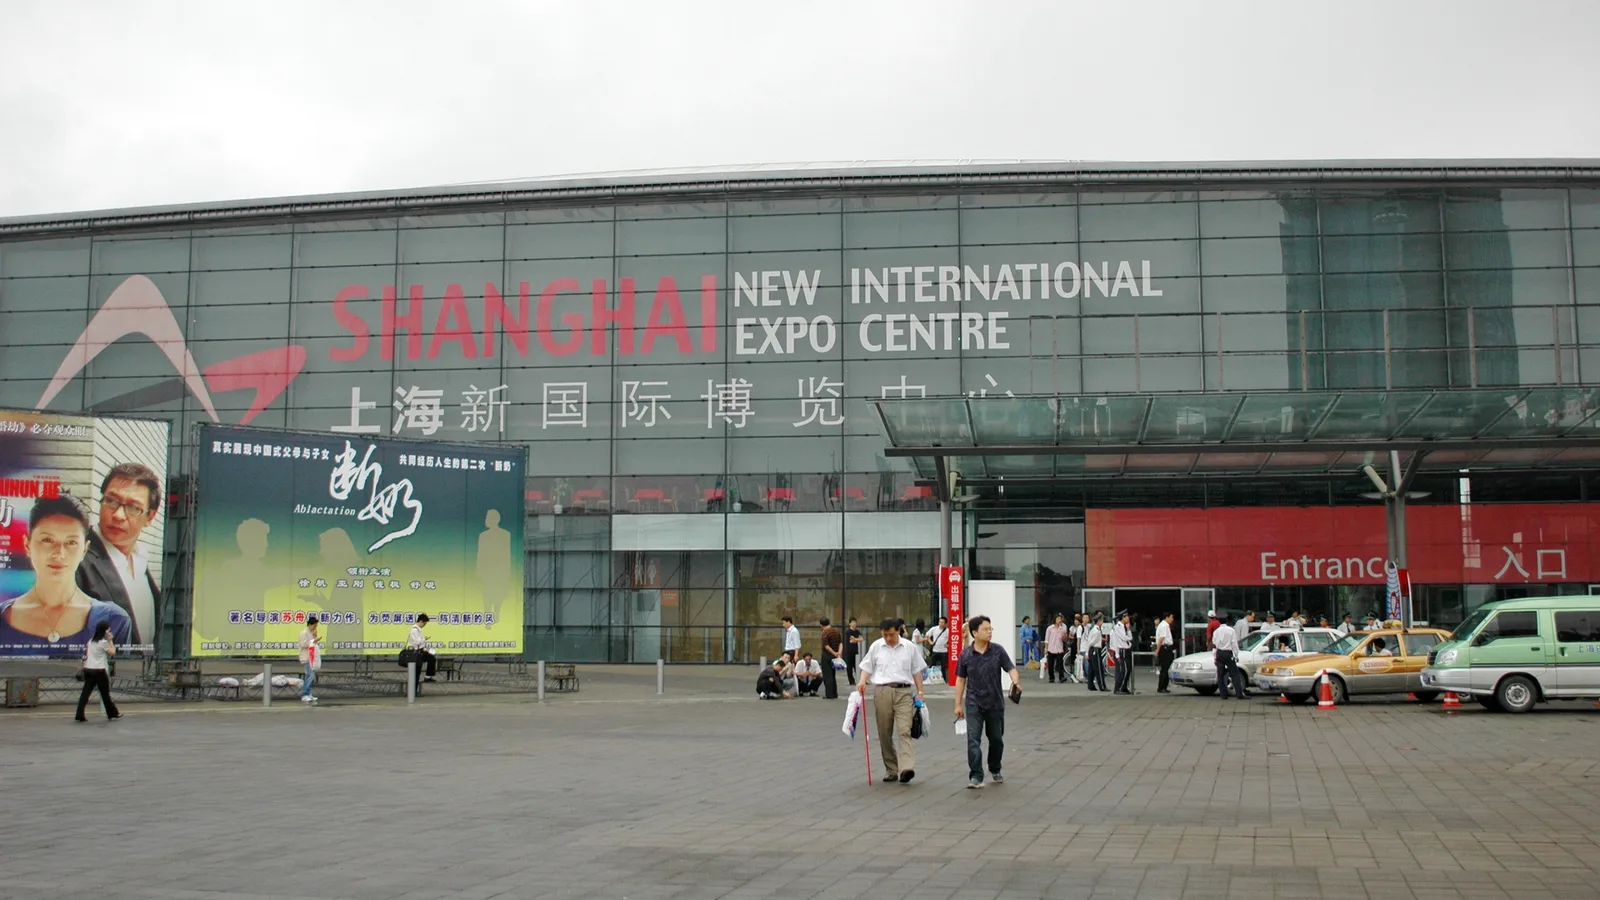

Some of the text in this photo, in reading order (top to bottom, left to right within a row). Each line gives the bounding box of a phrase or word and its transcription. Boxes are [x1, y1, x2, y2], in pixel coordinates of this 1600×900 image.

[734, 259, 1163, 307] NEW INTERNATIONAL
[329, 274, 718, 361] SHANGHAI
[736, 311, 1009, 355] EXPO CENTRE
[212, 441, 330, 460] 真实展现中国式父母与子女
[293, 503, 356, 516] Ablactation
[1494, 546, 1567, 580] 入口
[229, 611, 495, 626] 著名导演苏舟最新力作，为荧屏送一阵清新的风
[950, 585, 960, 661] 出租车 Taxi Stand
